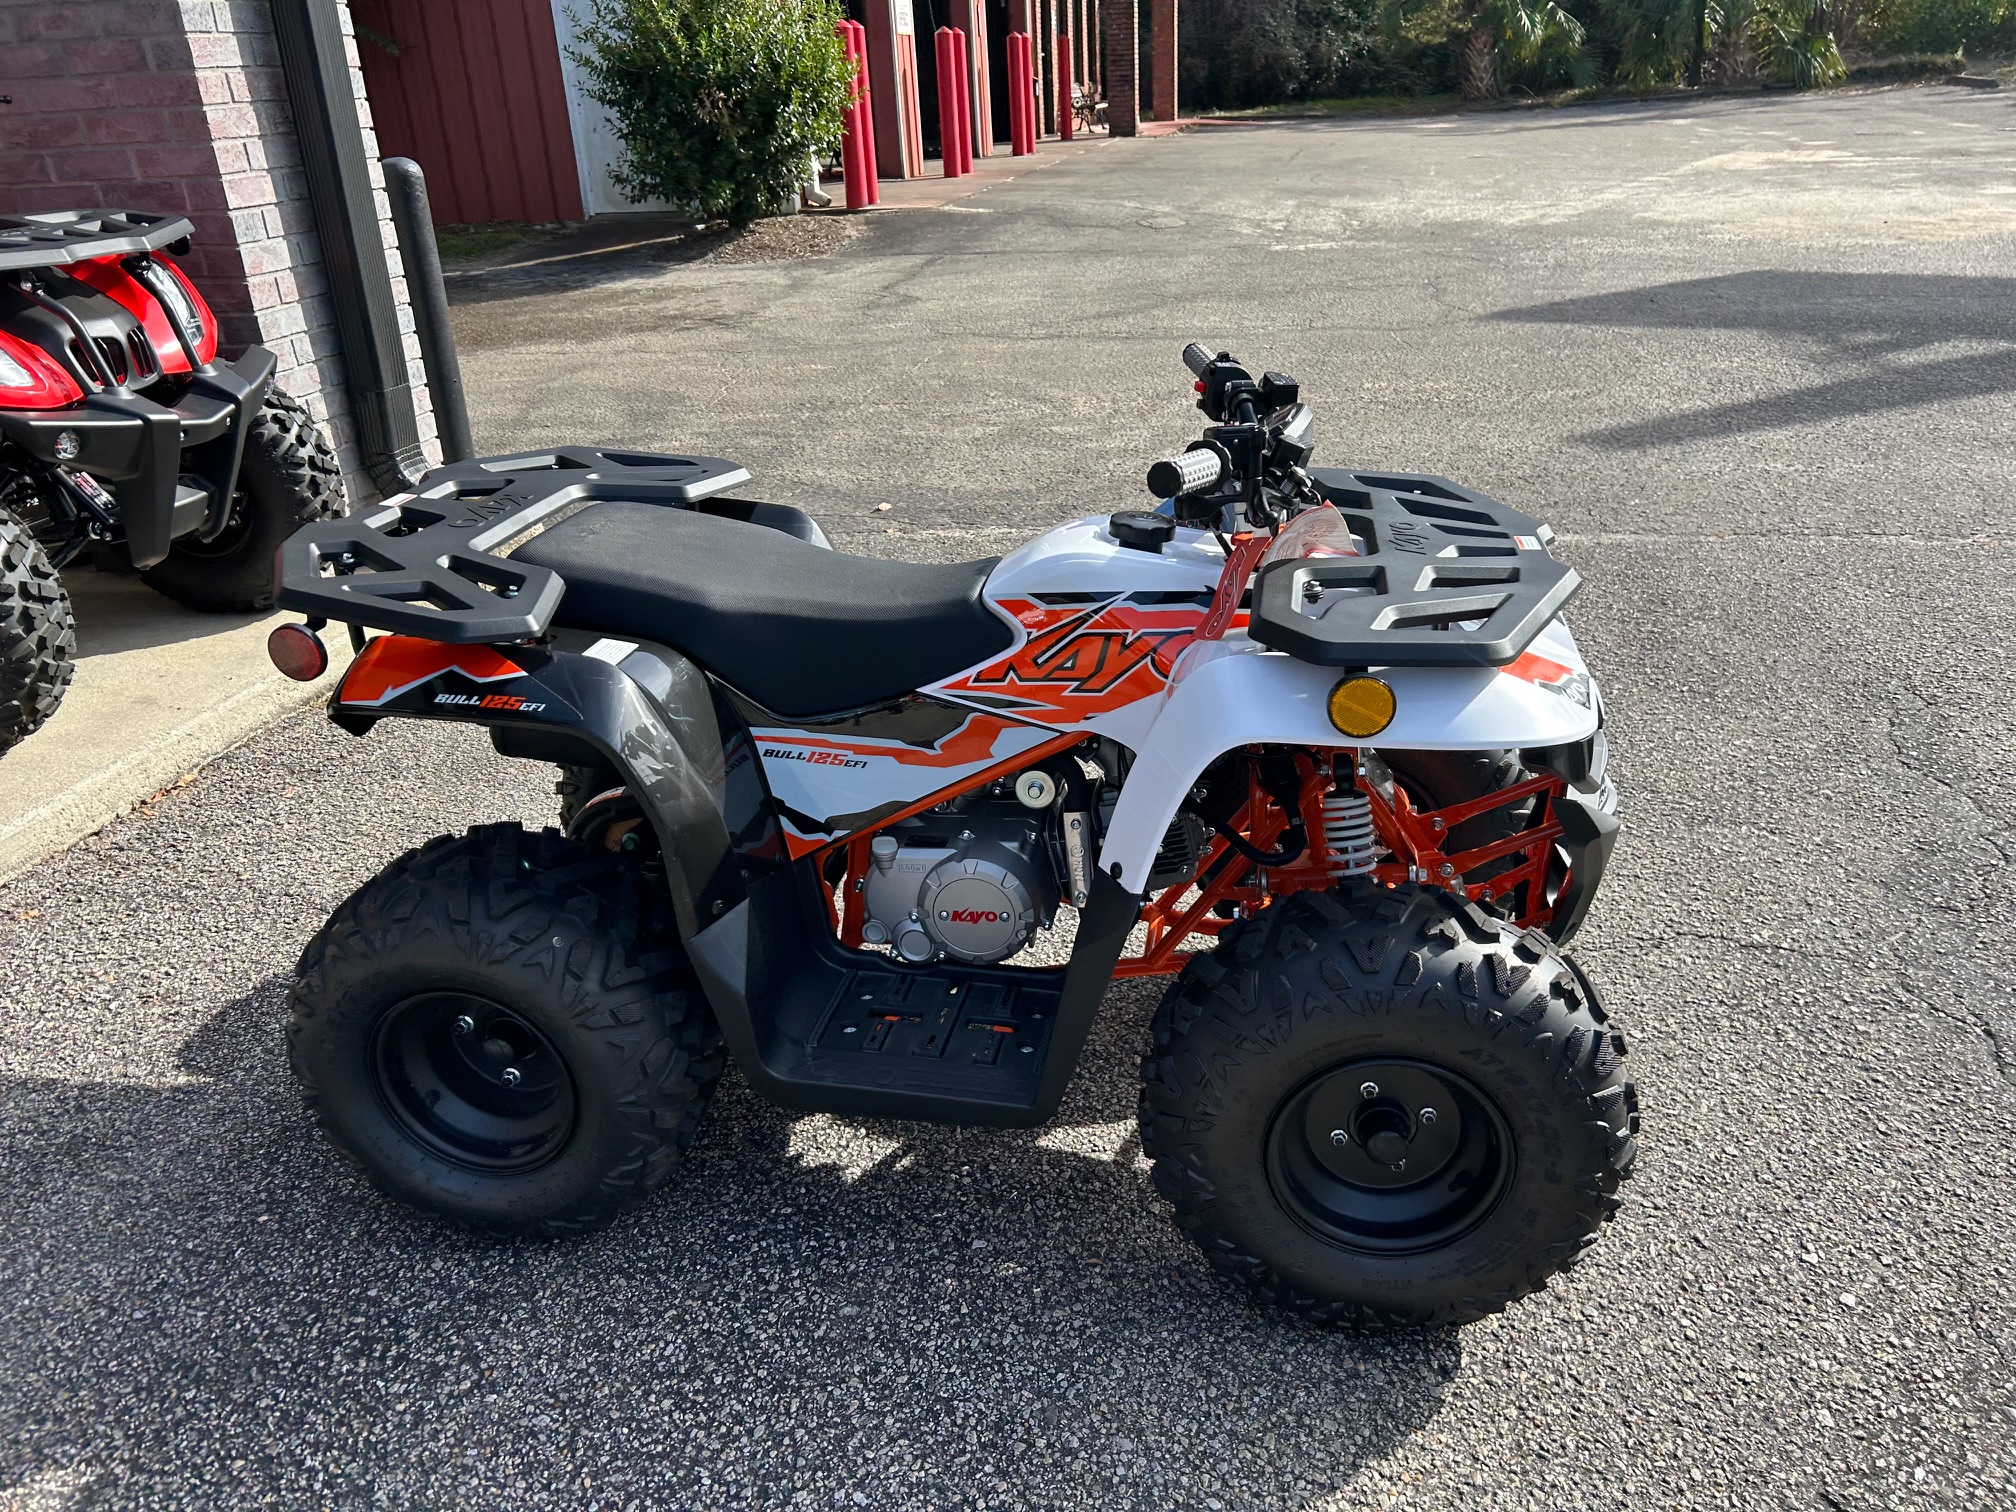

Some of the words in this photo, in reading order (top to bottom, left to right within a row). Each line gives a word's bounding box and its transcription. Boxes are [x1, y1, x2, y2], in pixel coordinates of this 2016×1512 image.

[434, 693, 546, 711] BULL125EFI
[762, 748, 868, 769] BULL125EFI
[950, 906, 998, 925] KAYO
